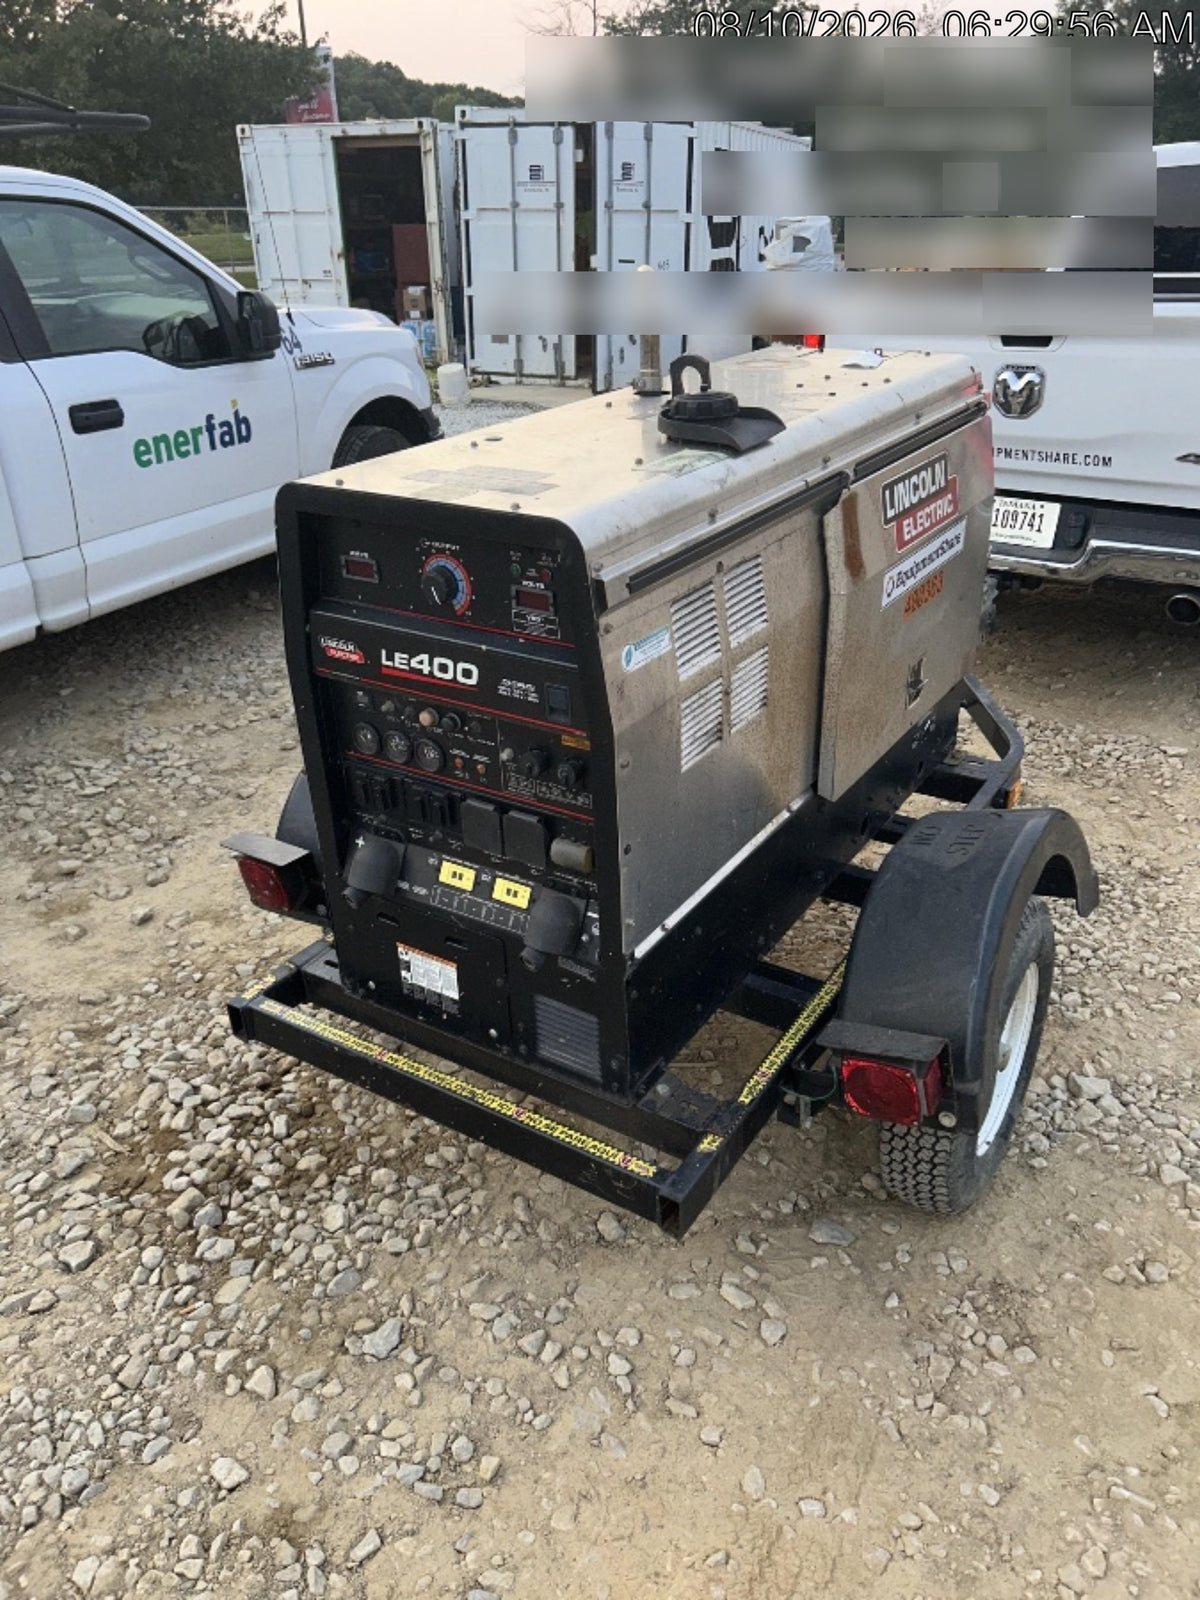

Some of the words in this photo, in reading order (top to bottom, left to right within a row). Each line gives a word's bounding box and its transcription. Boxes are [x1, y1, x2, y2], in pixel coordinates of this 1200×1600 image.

[133, 407, 252, 468] enerfab
[884, 459, 947, 519] LINCOLN
[902, 493, 954, 542] ELECTRIC
[991, 507, 1045, 534] 109741
[381, 649, 479, 686] LE400
